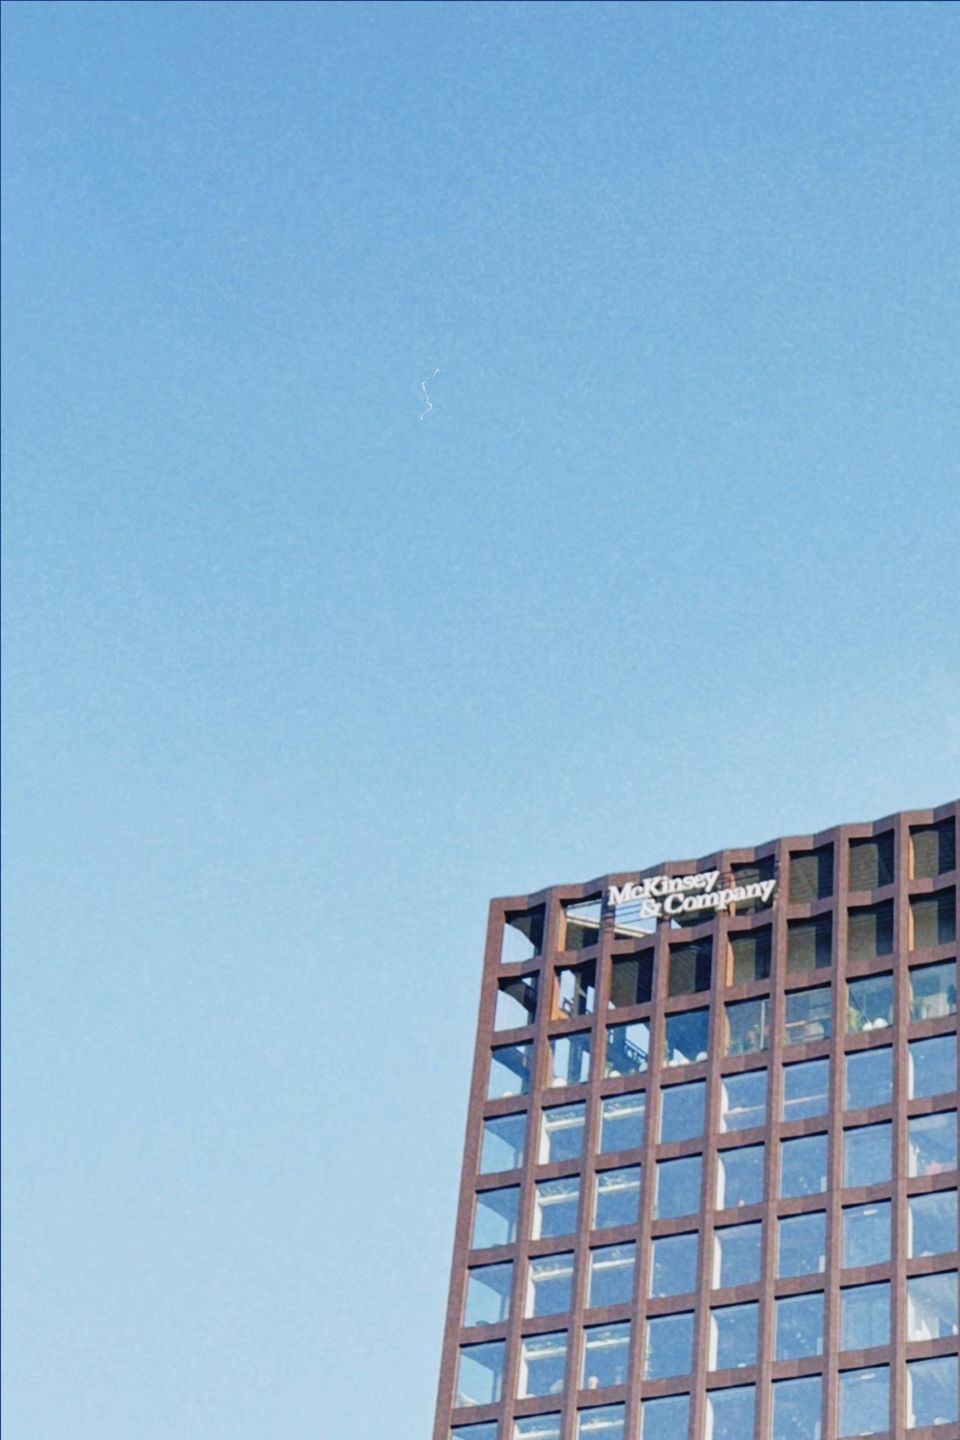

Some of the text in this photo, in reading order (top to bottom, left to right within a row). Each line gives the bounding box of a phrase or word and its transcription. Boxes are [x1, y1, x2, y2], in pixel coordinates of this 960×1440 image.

[608, 870, 720, 906] McKinsey
[640, 879, 776, 918] & Company
